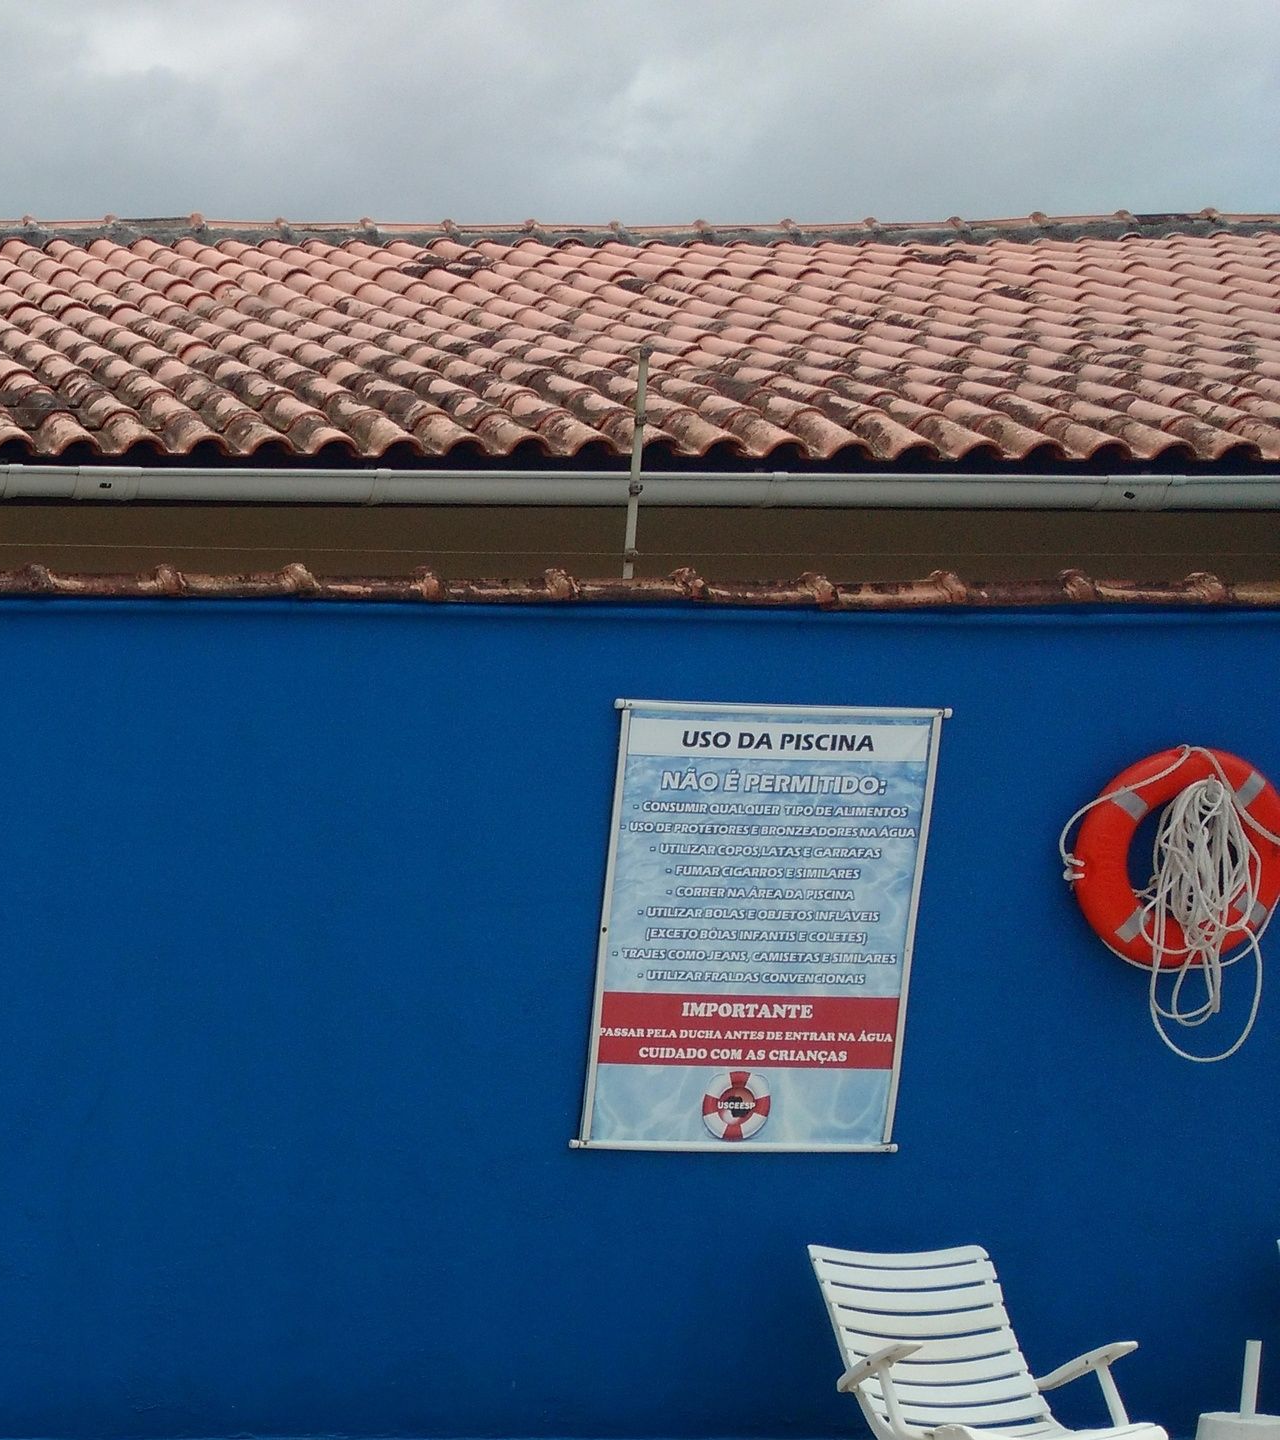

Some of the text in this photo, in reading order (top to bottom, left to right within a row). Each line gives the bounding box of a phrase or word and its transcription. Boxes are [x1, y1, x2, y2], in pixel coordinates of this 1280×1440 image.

[682, 731, 874, 752] USO DA PISCINA
[661, 767, 887, 796] NÃO É PERMITIDO:
[642, 801, 908, 818] CONSUMIR QUALQUER TIPO DE ALIMENTOS
[629, 821, 915, 838] USO DE PROTETORES E BRONZEADORES NA ÁGUA
[659, 843, 716, 855] UTILIZAR
[803, 847, 812, 857] E
[813, 847, 882, 859] GARRAFAS
[675, 865, 861, 880] FUMAR CIGARROS E SIMILARES
[676, 886, 855, 901] CORRER NA ÁREA DA PISCINA
[646, 906, 703, 918] UTILIZAR
[704, 908, 745, 920] BOLAS
[747, 909, 756, 920] E
[757, 910, 813, 922] OBJETOS
[699, 928, 737, 941] BÓIAS
[739, 930, 796, 942] INFANTIS
[798, 932, 807, 942] E
[622, 948, 897, 965] TRAJES COMO JEANS, CAMISETAS E SIMILARES
[646, 970, 865, 985] UTILIZAR FRALDAS CONVENCIONAIS
[682, 1001, 814, 1019] IMPORTANTE
[599, 1027, 893, 1043] PASSAR PELA DUCHA ANTES DE ENTRAR NA ÁGUA
[639, 1047, 848, 1064] CUIDADO COM AS CRIANÇAS
[717, 1101, 756, 1110] USCEESP
